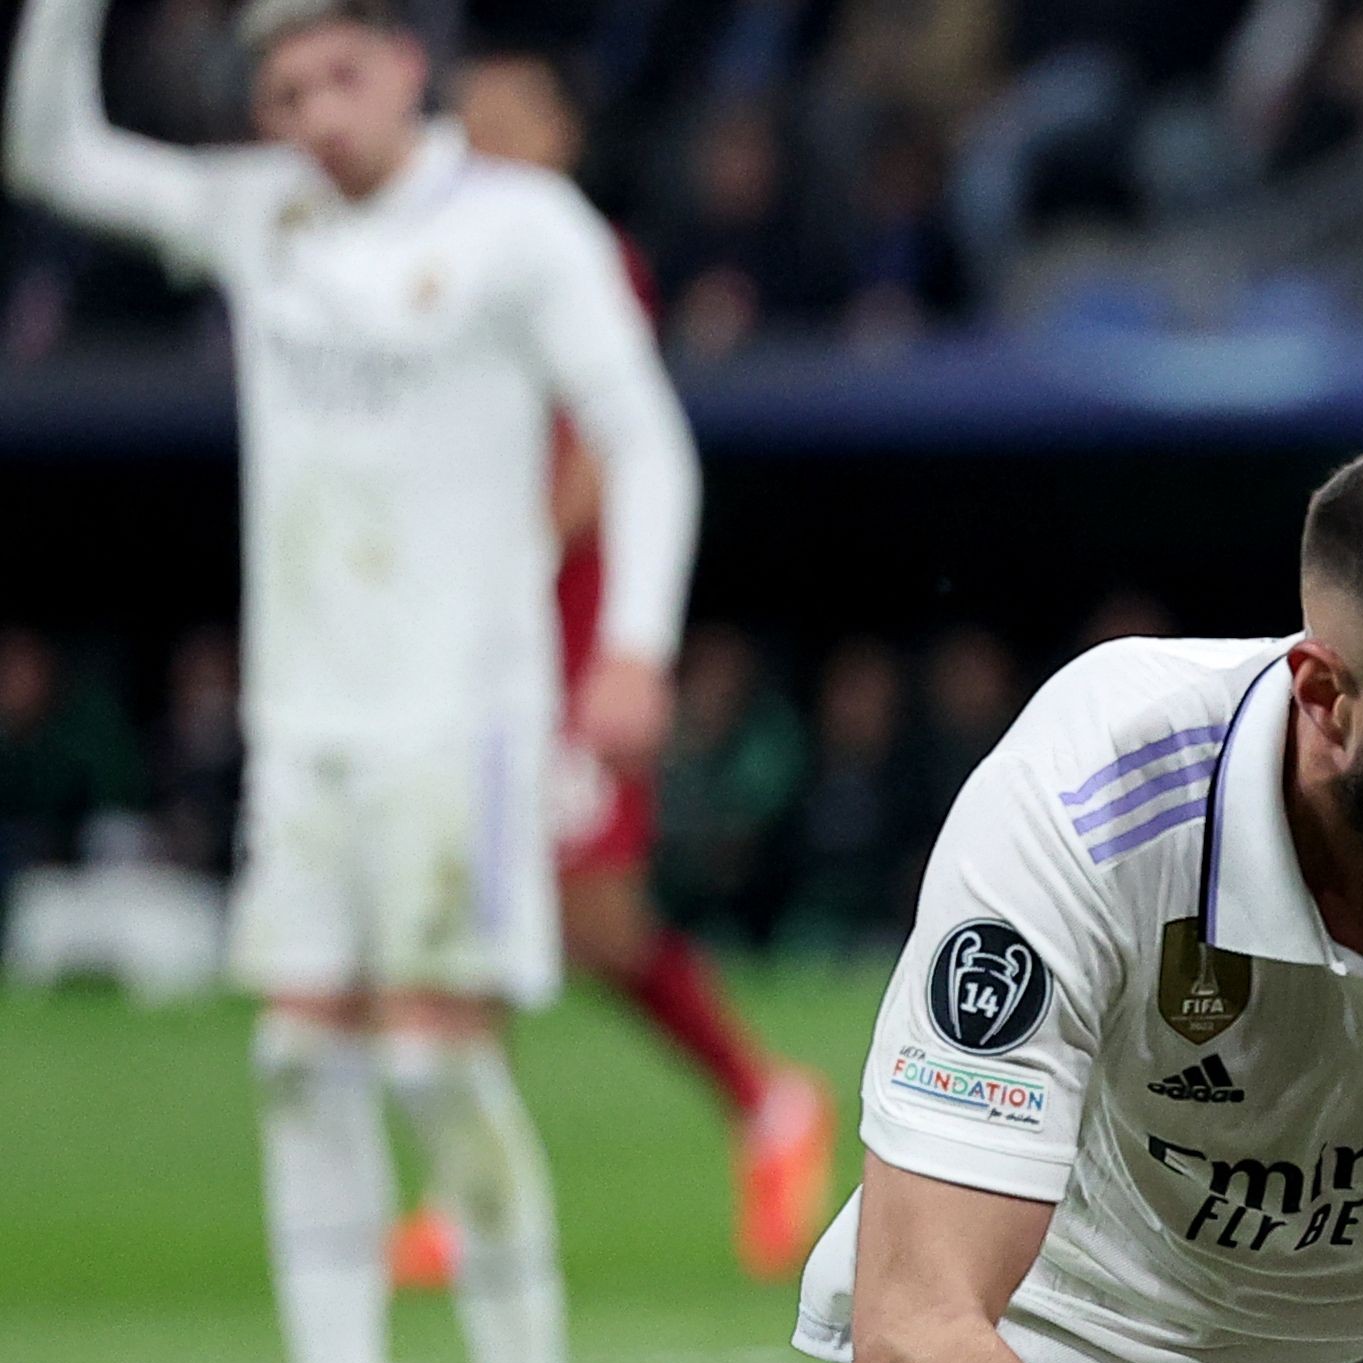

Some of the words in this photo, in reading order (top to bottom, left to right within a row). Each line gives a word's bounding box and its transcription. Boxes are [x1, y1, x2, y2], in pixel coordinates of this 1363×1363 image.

[960, 982, 1000, 1018] 14
[1182, 998, 1224, 1015] FIFA
[899, 1045, 926, 1060] UEFA
[892, 1058, 1044, 1111] FOUNDATION
[1186, 1194, 1291, 1251] FLY
